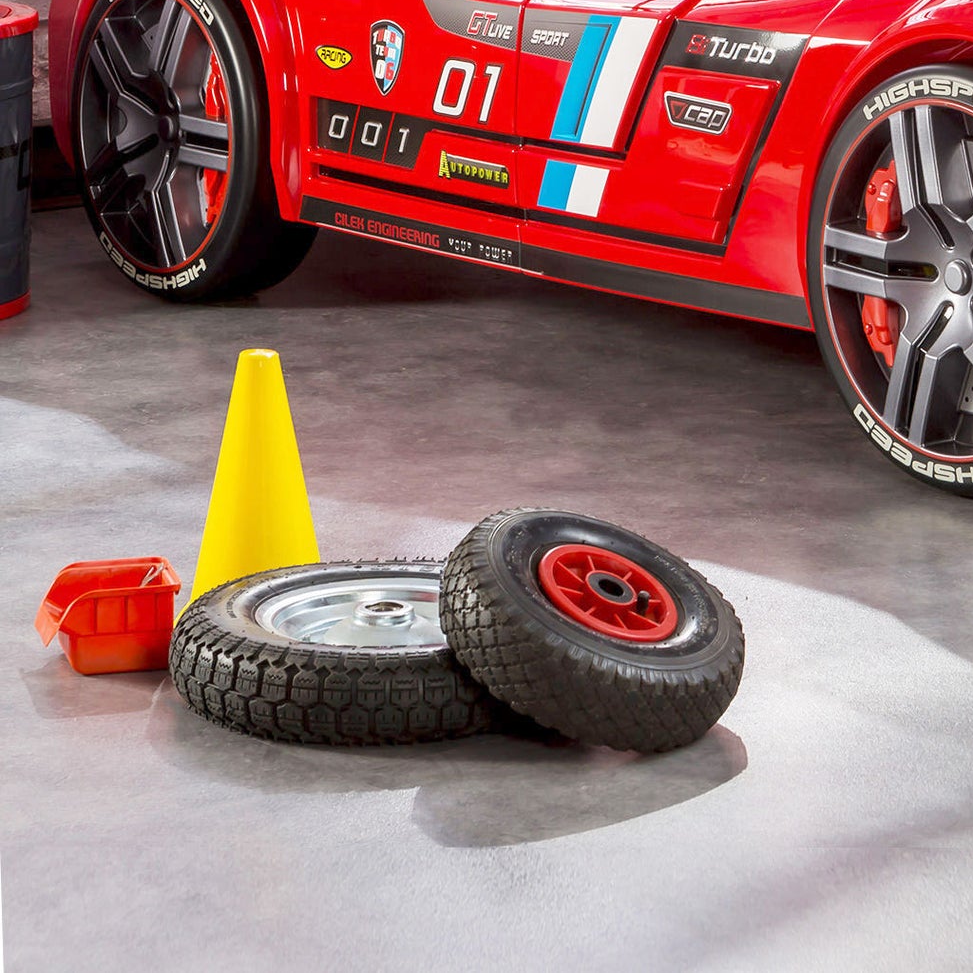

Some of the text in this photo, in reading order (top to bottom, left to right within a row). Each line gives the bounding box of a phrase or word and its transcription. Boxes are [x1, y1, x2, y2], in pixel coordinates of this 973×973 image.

[530, 28, 570, 48] SPORT
[374, 58, 396, 81] 06
[431, 56, 505, 124] 01
[100, 230, 207, 290] HIGHSPEED
[334, 211, 365, 231] CILEK
[366, 219, 441, 249] ENGINEERING
[478, 243, 514, 264] POWER
